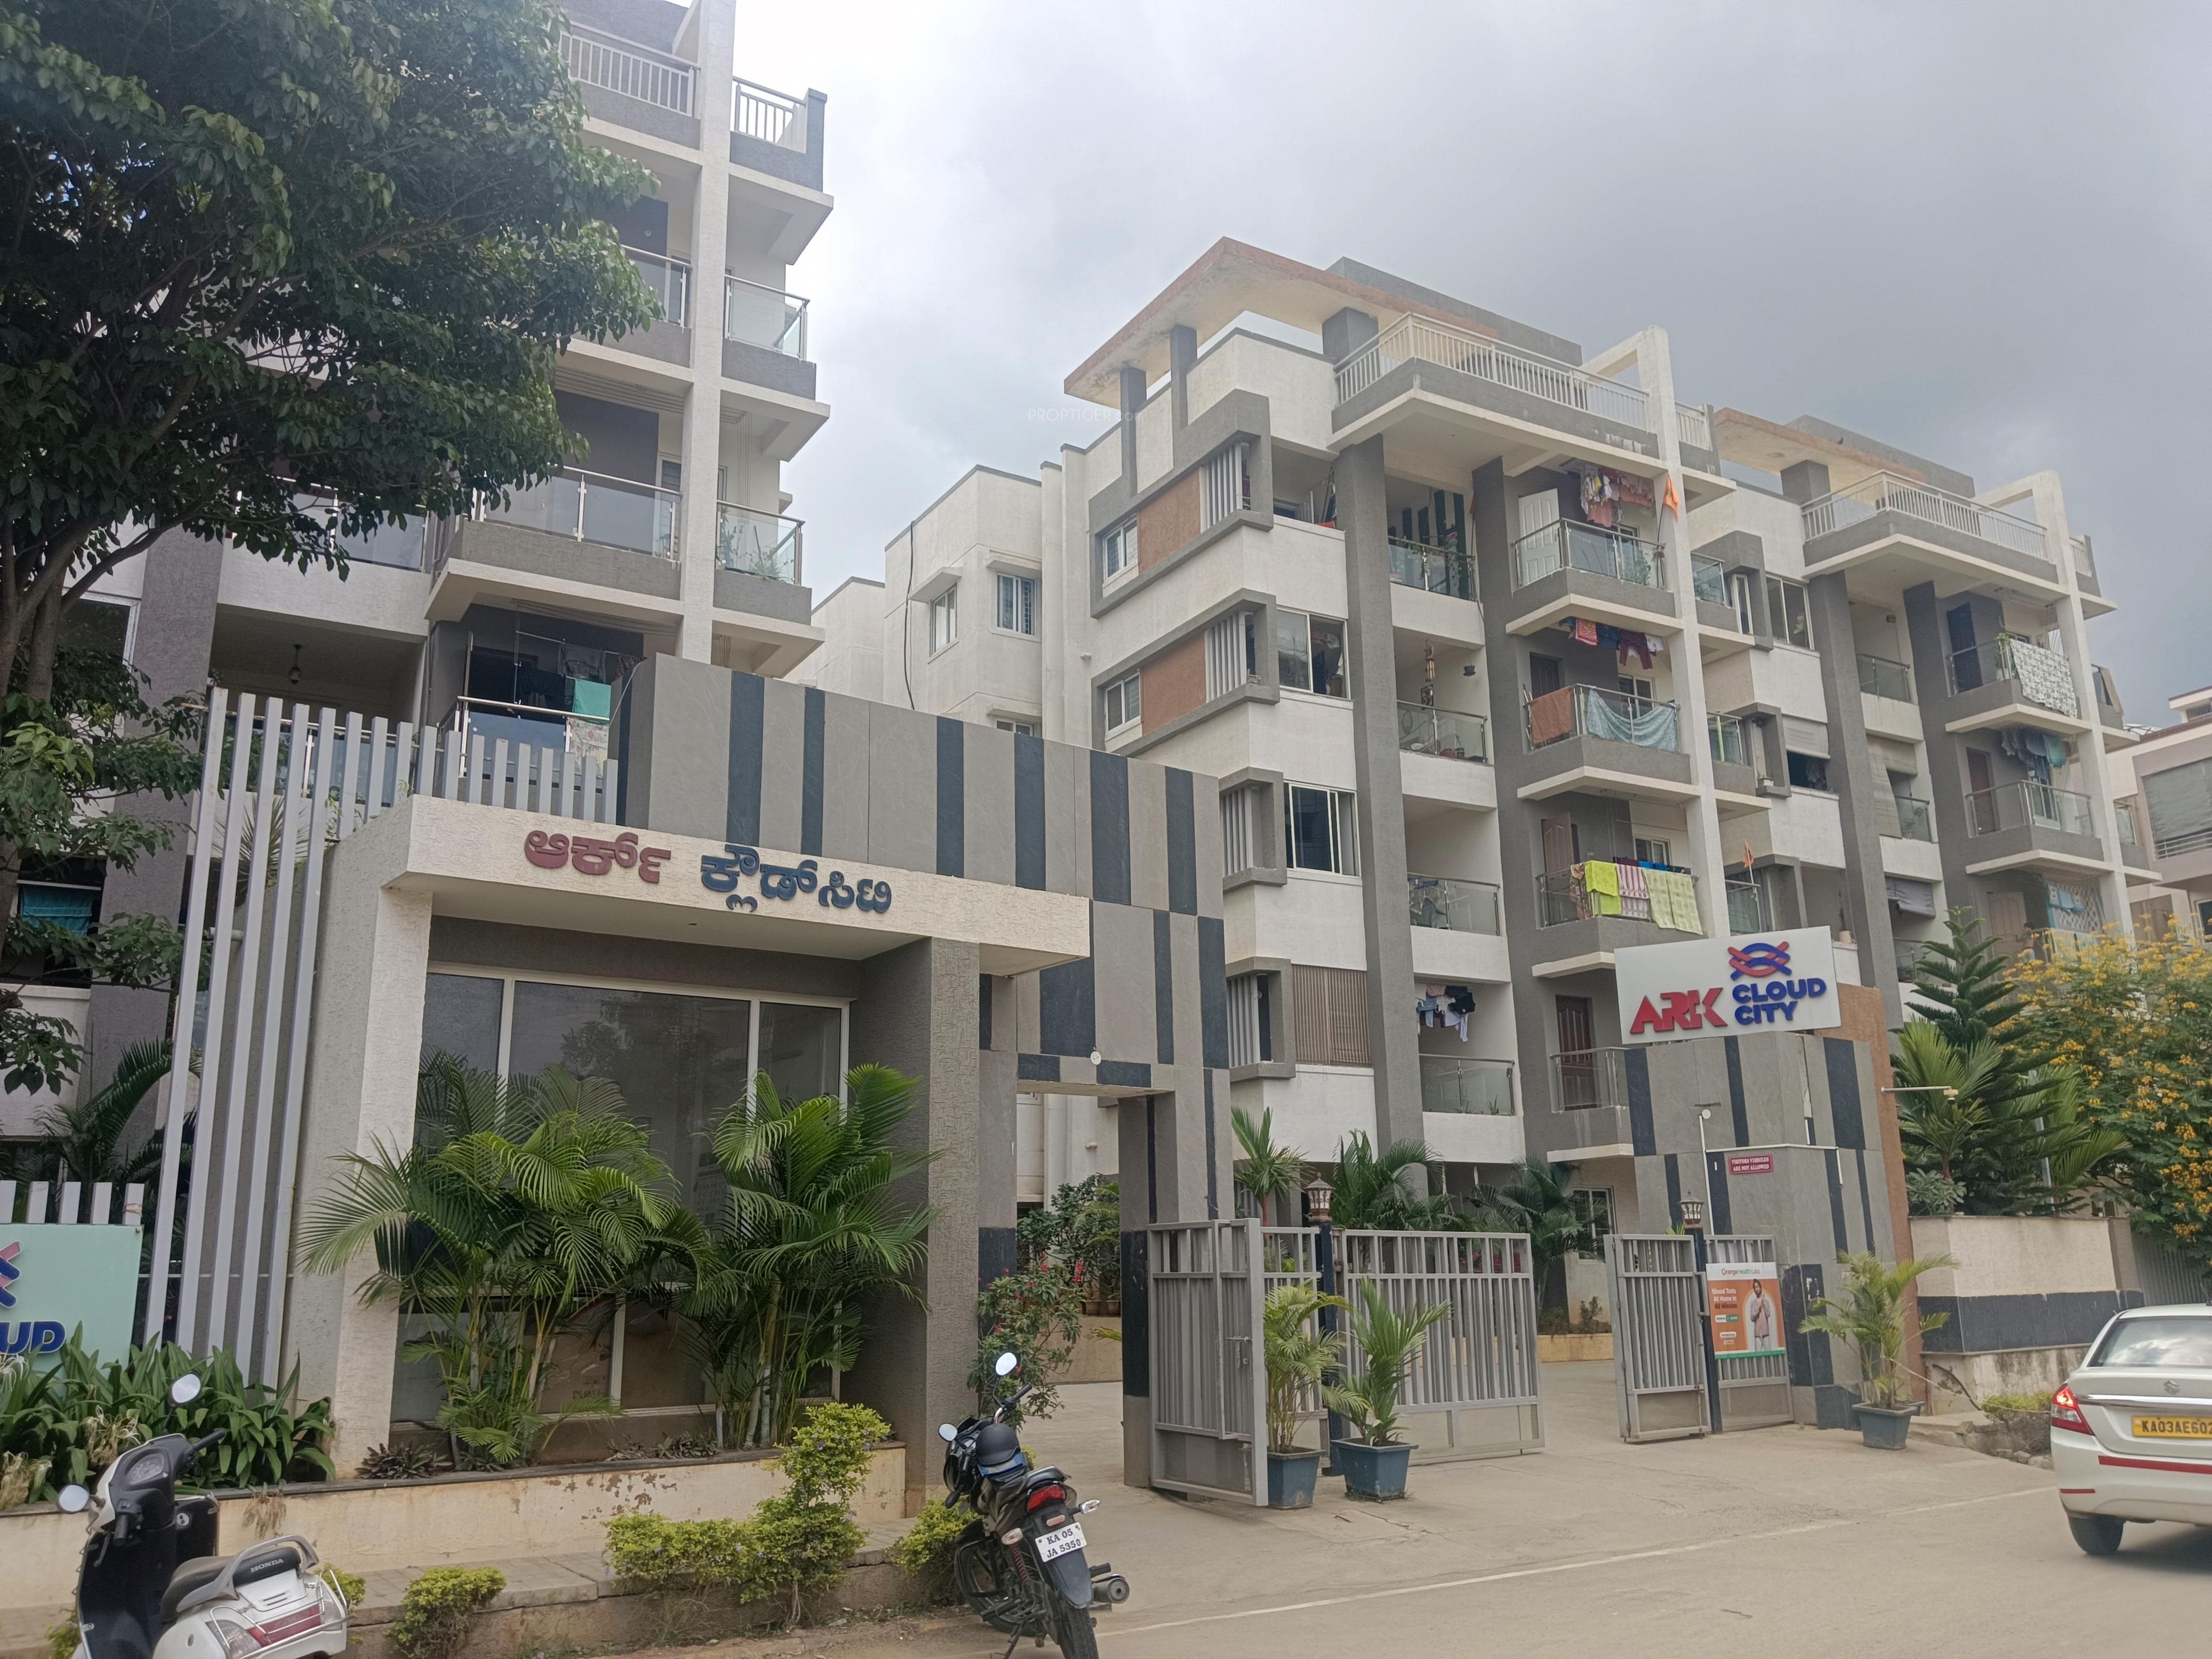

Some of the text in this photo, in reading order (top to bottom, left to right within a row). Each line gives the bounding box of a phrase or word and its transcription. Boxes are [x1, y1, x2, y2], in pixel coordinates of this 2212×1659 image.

[1732, 978, 1827, 1004] CLOUD
[1630, 987, 1728, 1035] ARK
[1734, 1001, 1798, 1025] CITY
[1722, 1268, 1738, 1276] Orange
[1046, 1528, 1073, 1544] KA 05
[1047, 1539, 1081, 1558] JA 5350
[251, 1558, 285, 1573] HONDA
